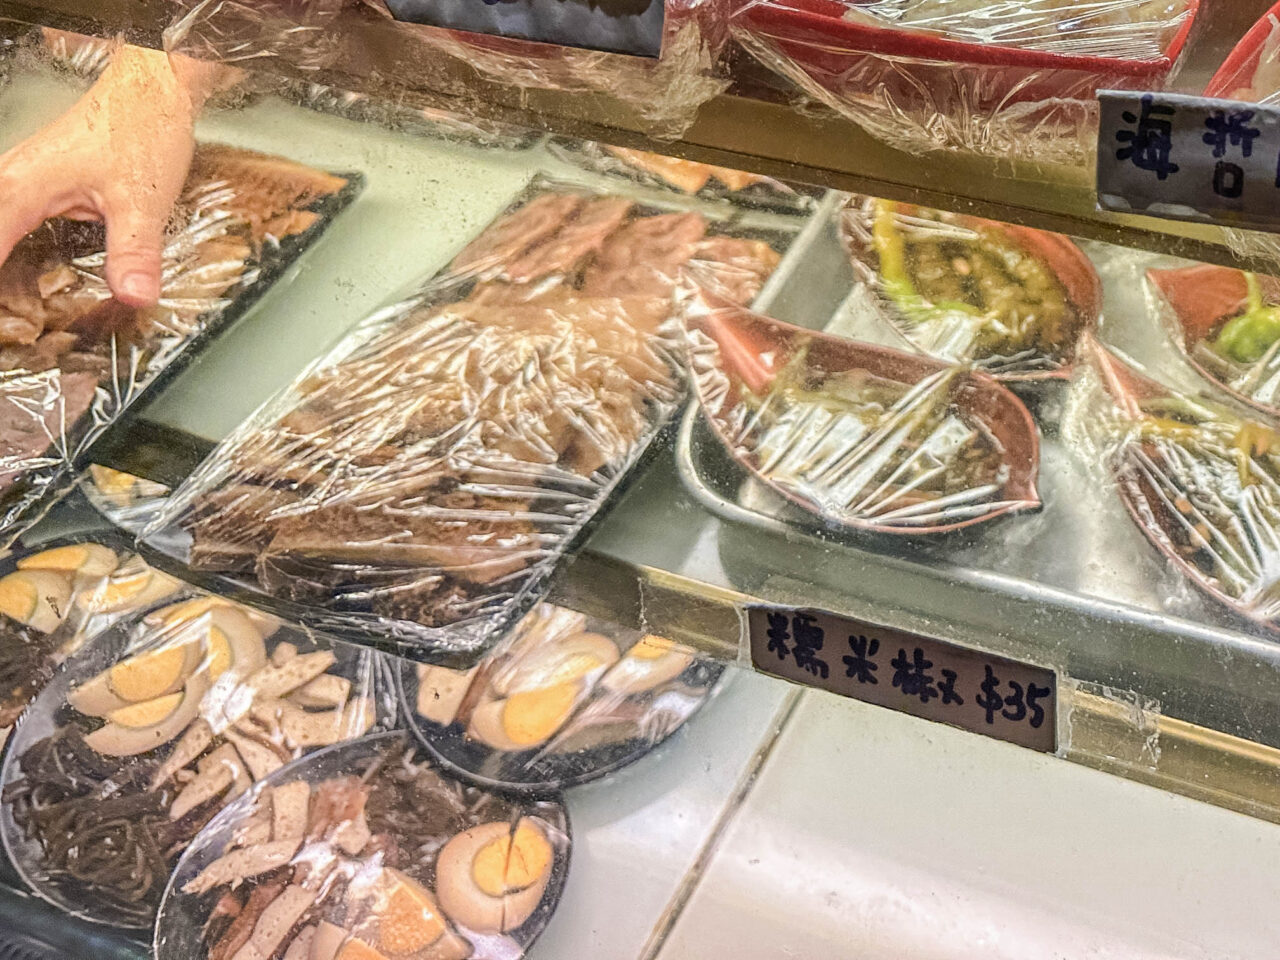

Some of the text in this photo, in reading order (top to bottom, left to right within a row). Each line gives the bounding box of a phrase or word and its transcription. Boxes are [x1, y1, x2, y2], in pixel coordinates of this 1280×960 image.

[766, 611, 1051, 729] 糯米椒 $35
